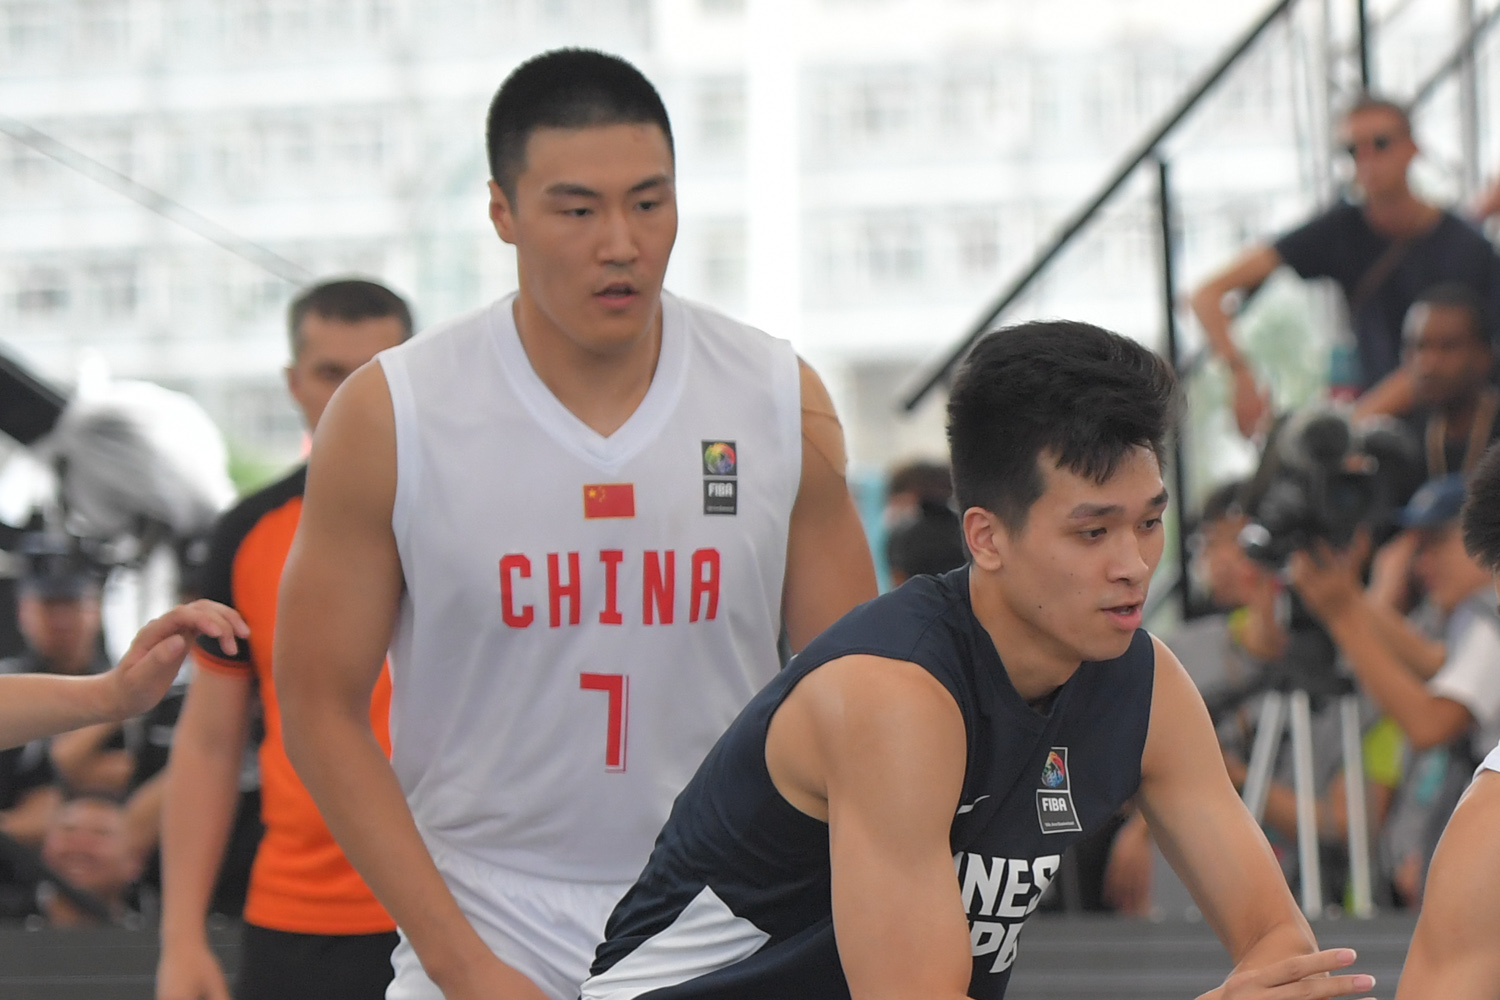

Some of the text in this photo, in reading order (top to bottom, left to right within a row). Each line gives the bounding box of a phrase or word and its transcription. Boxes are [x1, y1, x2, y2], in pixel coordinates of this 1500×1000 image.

[708, 482, 733, 497] FIBA
[498, 547, 721, 629] CHINA
[579, 672, 630, 774] 7
[1041, 797, 1068, 812] FIBA
